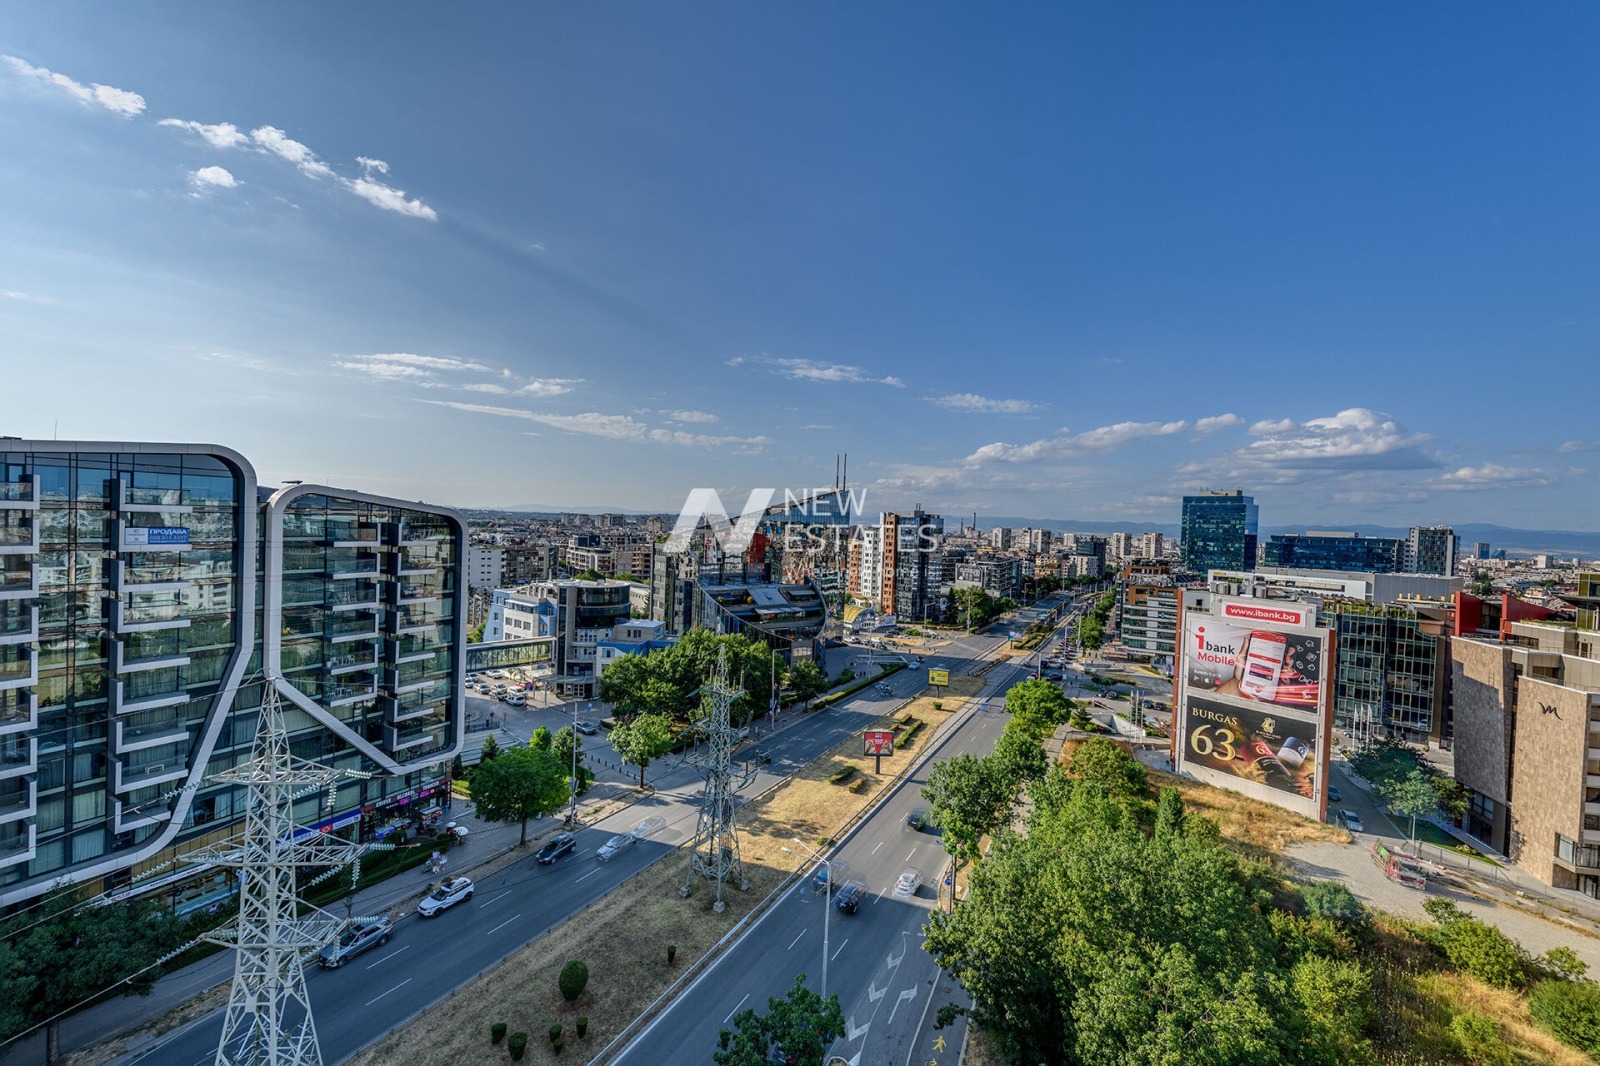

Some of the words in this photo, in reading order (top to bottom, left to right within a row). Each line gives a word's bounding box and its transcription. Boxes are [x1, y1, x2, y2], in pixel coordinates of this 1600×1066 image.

[1230, 607, 1296, 622] www.ibank.bg
[1197, 652, 1235, 666] Mobile
[1192, 707, 1238, 726] BURGAS
[1190, 724, 1236, 761] 63
